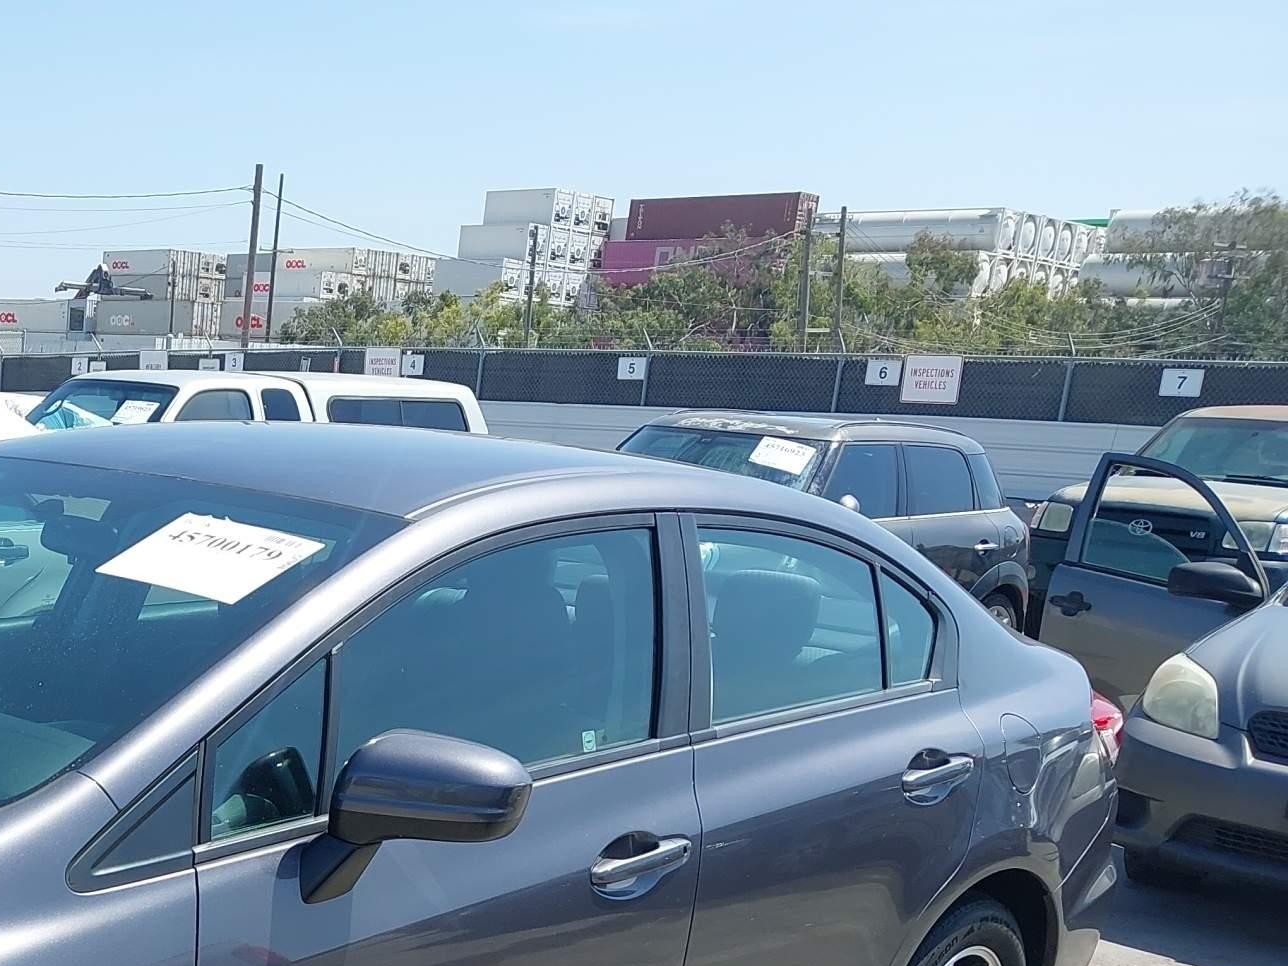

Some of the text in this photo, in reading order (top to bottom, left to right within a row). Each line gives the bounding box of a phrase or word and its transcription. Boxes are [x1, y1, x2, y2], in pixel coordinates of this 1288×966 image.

[76, 361, 83, 371] 2
[231, 357, 237, 368] 3
[409, 359, 416, 370] 4
[627, 362, 636, 374] 5
[878, 366, 889, 380] 6
[910, 368, 955, 378] INSPECTIONS
[914, 380, 947, 390] VEHICLES
[1176, 375, 1188, 390] 7
[1189, 531, 1207, 539] V8
[168, 529, 284, 561] 45700179
